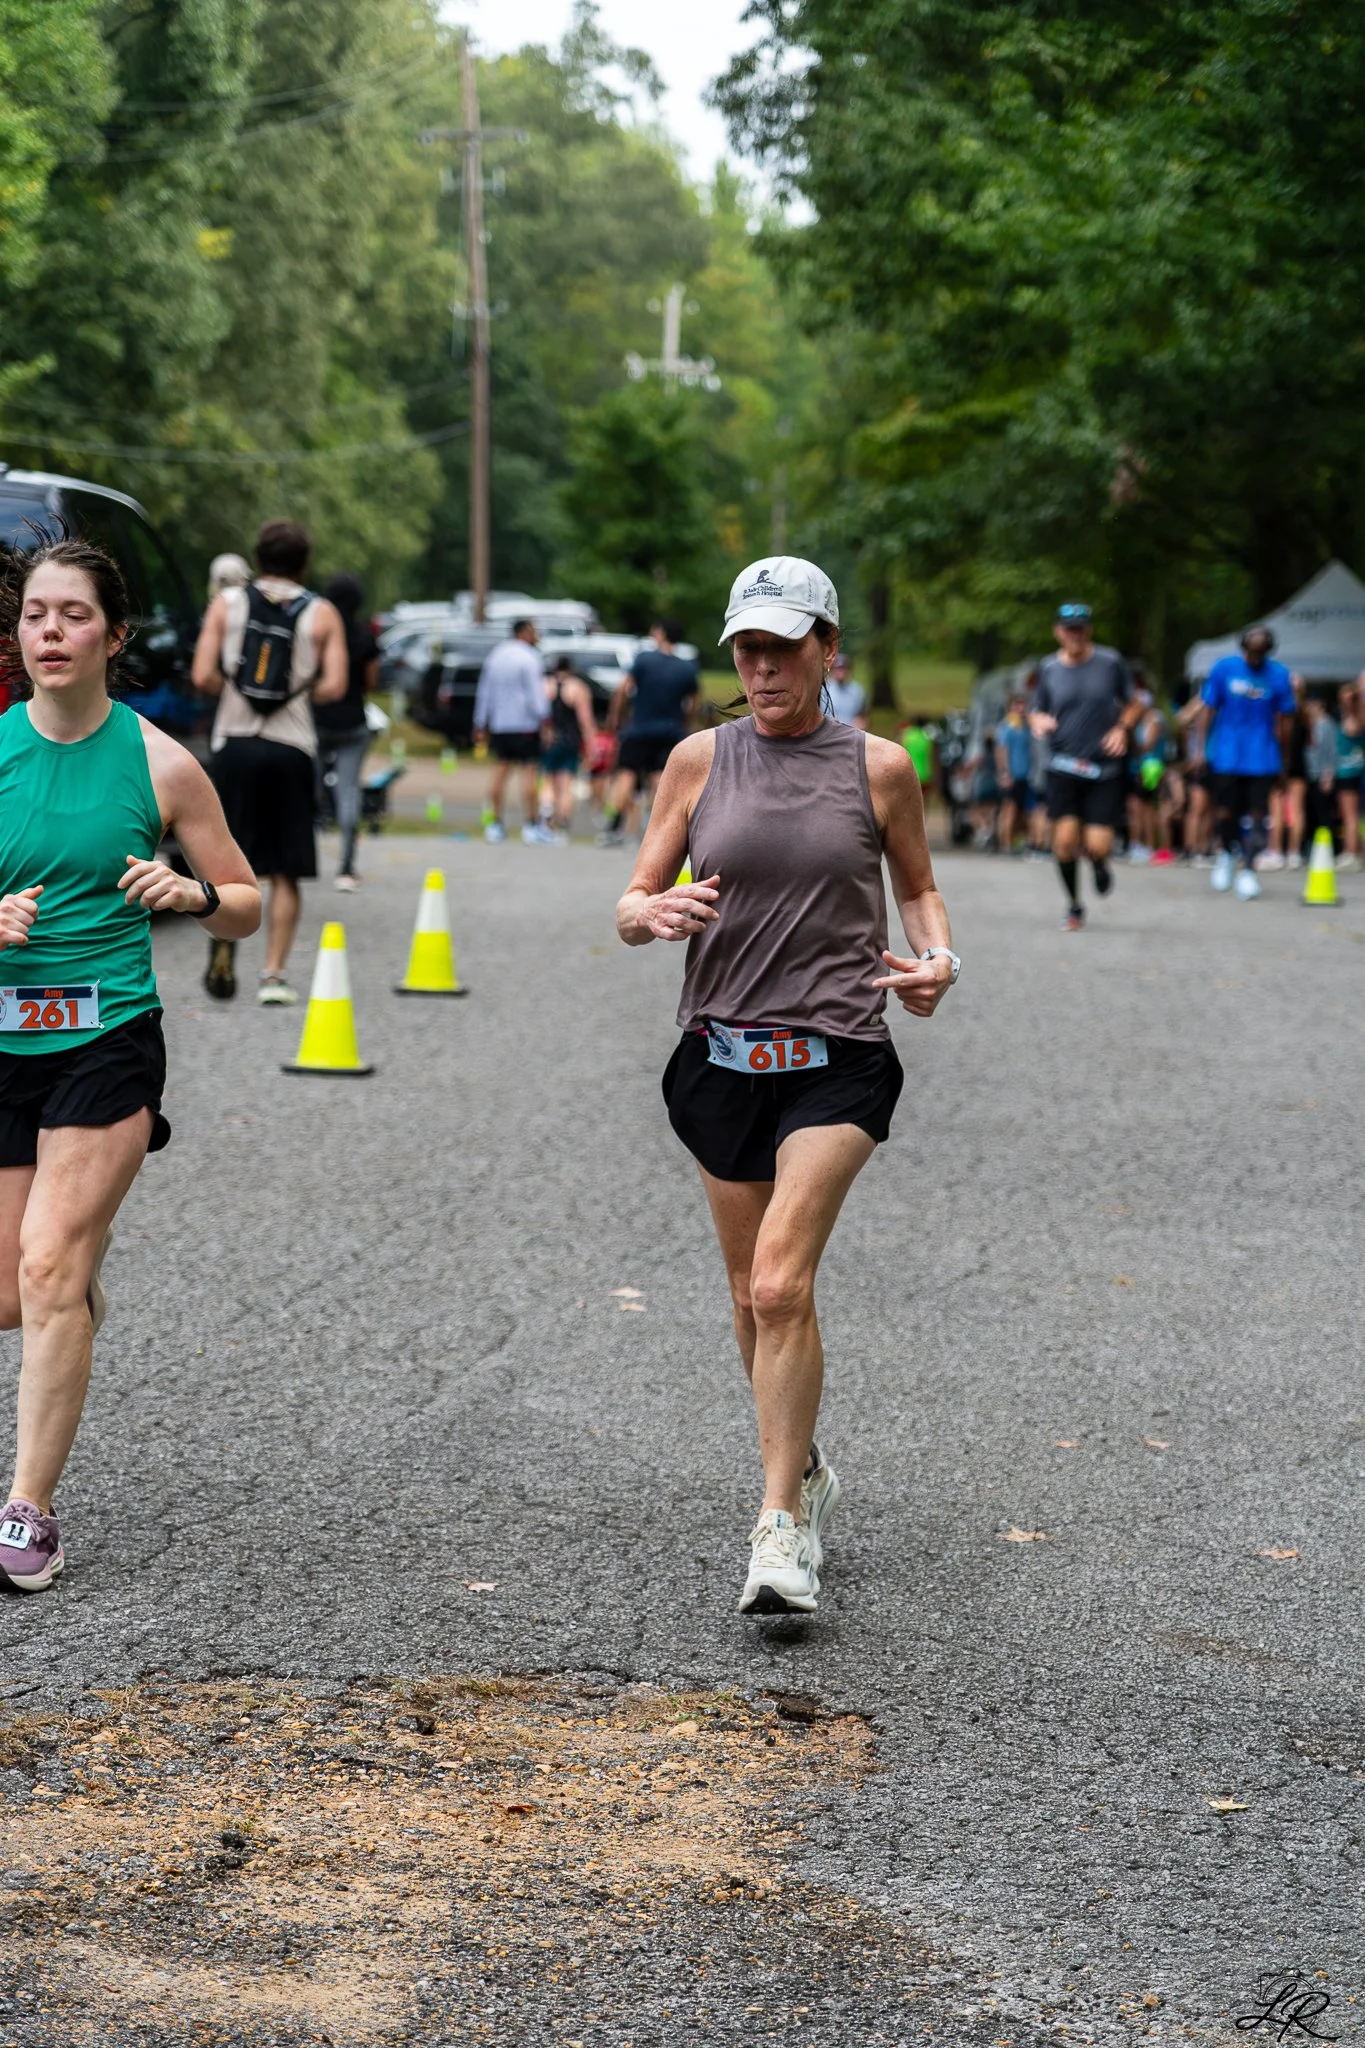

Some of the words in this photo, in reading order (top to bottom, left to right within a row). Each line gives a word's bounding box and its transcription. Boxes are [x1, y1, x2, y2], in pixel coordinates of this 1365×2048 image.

[44, 989, 64, 998] Amy
[19, 1000, 78, 1029] 261
[773, 1030, 793, 1040] Amy
[748, 1039, 811, 1071] 615
